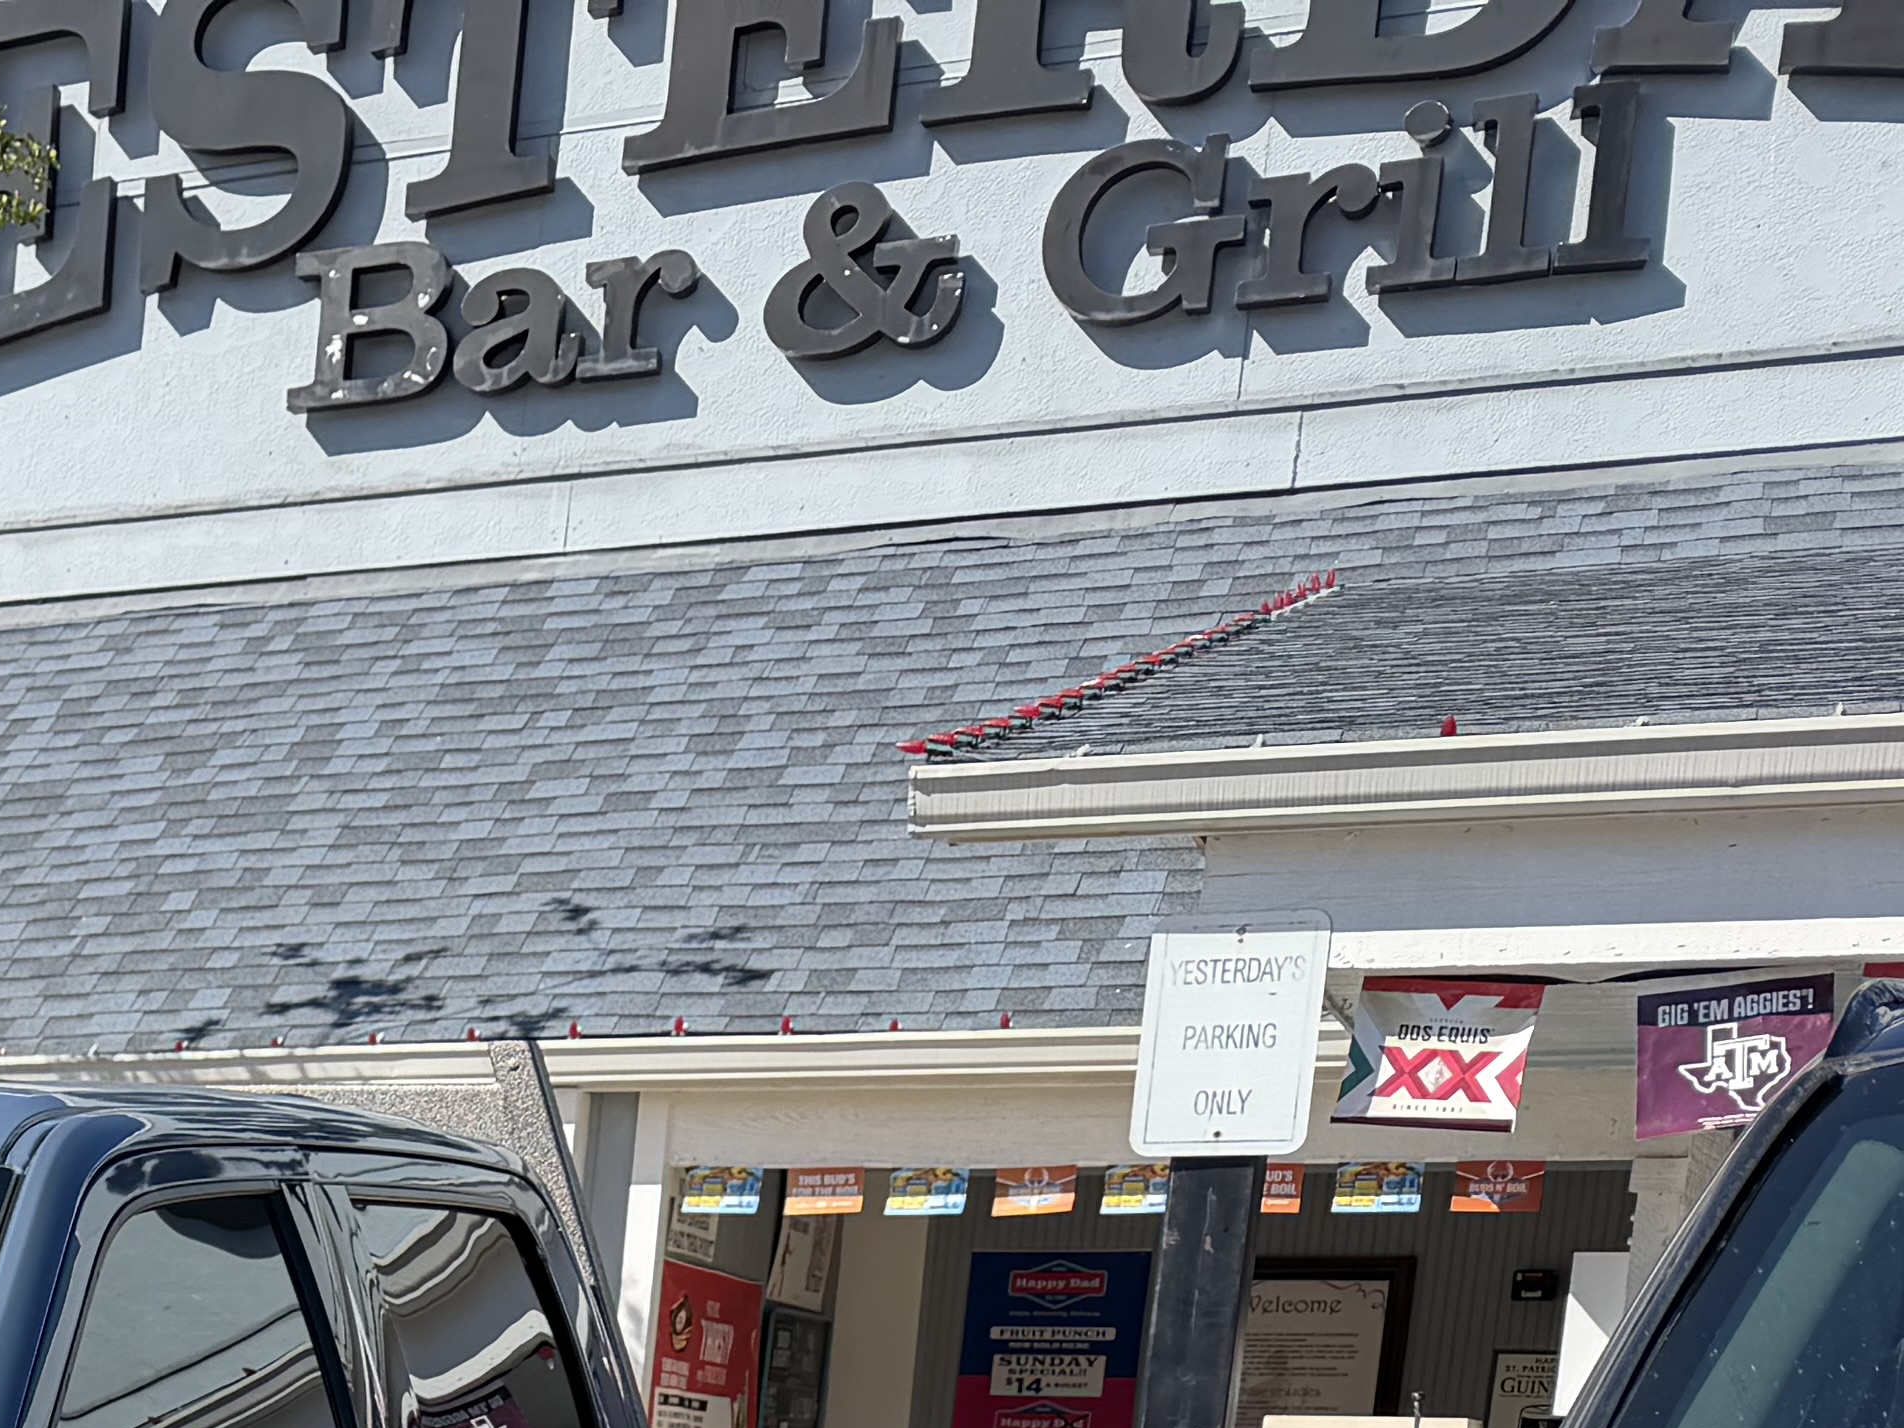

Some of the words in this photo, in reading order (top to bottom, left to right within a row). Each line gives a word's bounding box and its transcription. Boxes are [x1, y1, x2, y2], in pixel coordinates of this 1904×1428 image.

[287, 242, 700, 413] Bar
[763, 182, 966, 360] &
[1042, 81, 1649, 326] Grill
[1170, 955, 1307, 986] YESTERDAY'S
[1658, 1004, 1689, 1027] GIG
[1694, 997, 1729, 1023] 'EM
[1182, 1023, 1278, 1050] PARKING
[1398, 1023, 1433, 1042] DOS
[1436, 1026, 1492, 1044] EQUIS
[1367, 1044, 1504, 1103] XX
[1194, 1089, 1252, 1115] ONLY
[1015, 1277, 1067, 1289] Happy
[1069, 1277, 1101, 1288] Dad
[999, 1328, 1050, 1338] FRUIT
[1051, 1328, 1107, 1339] PUNCH
[998, 1356, 1099, 1367] SUNDAY
[1006, 1377, 1043, 1395] $14
[1000, 1417, 1053, 1428] Happy
